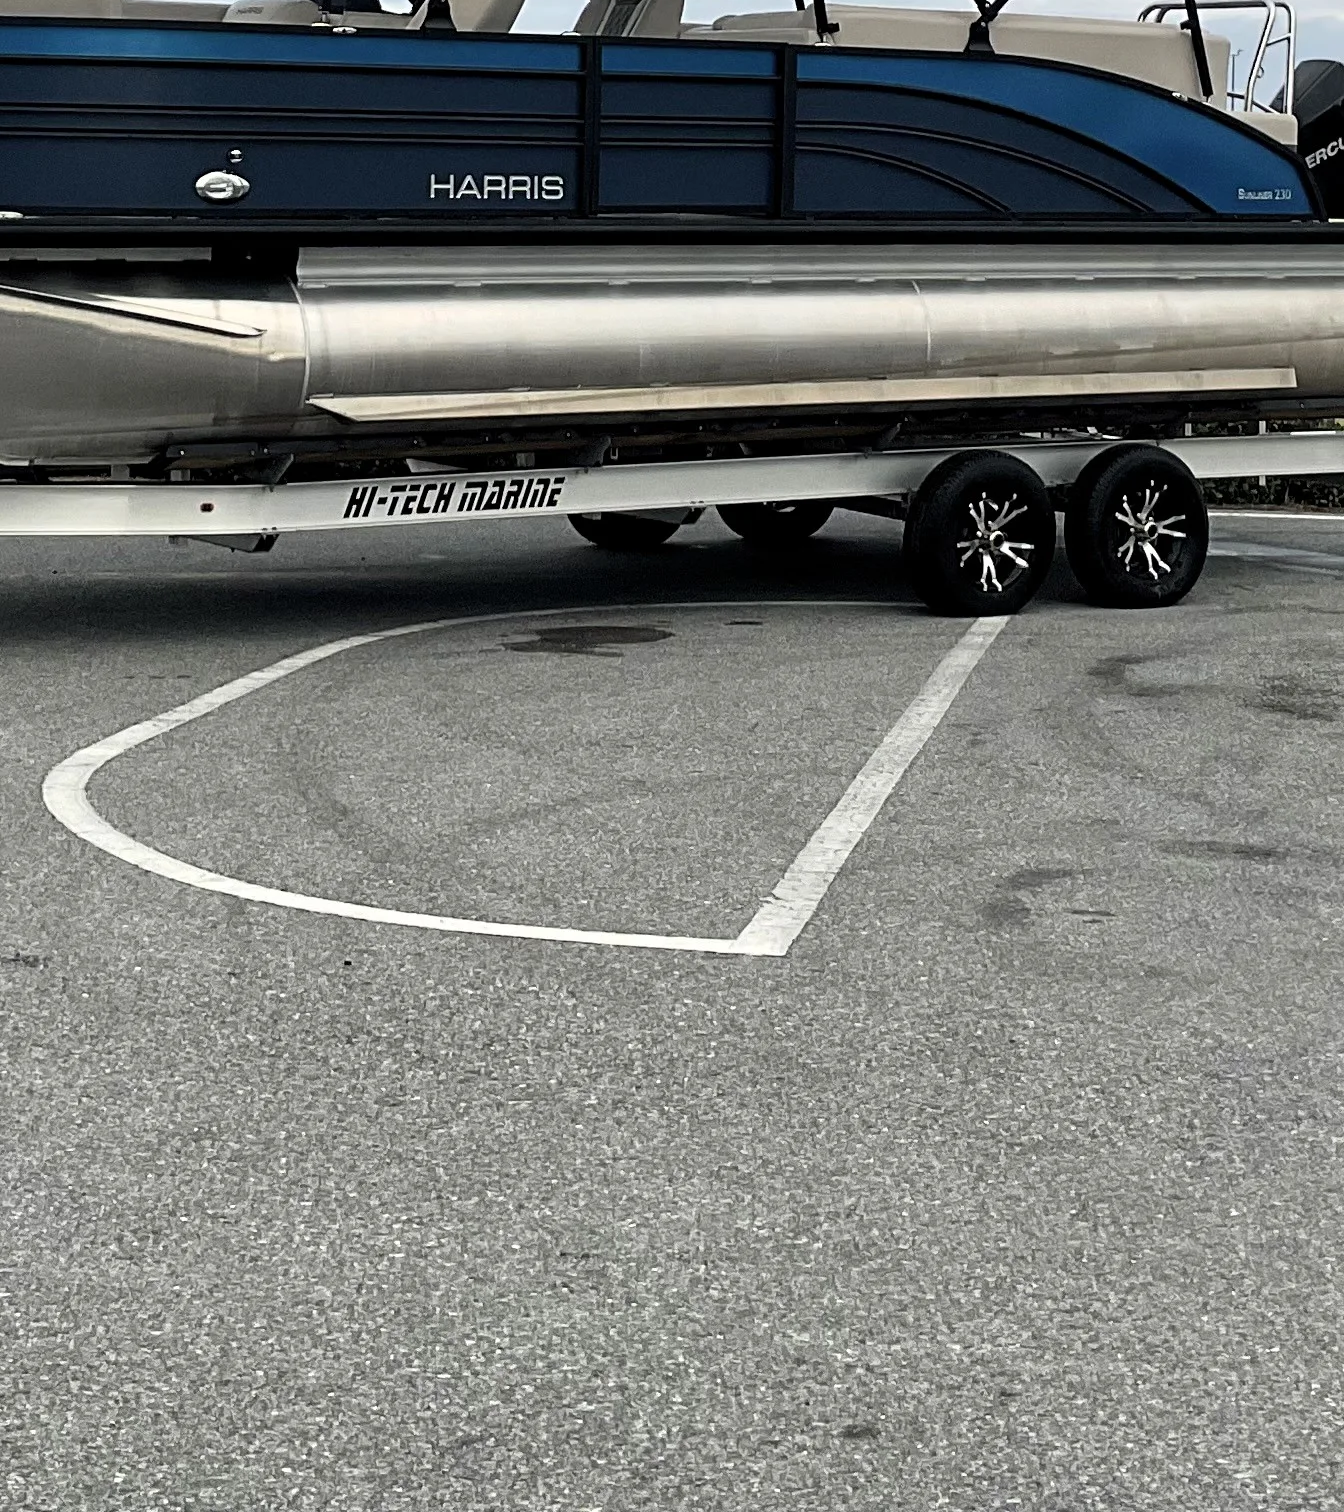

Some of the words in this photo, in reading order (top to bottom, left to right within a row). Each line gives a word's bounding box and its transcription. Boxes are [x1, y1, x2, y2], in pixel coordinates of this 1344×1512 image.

[429, 173, 564, 200] HARRIS
[1274, 188, 1292, 200] 230
[343, 482, 456, 519] HI-TECH
[457, 476, 566, 513] MARINE
